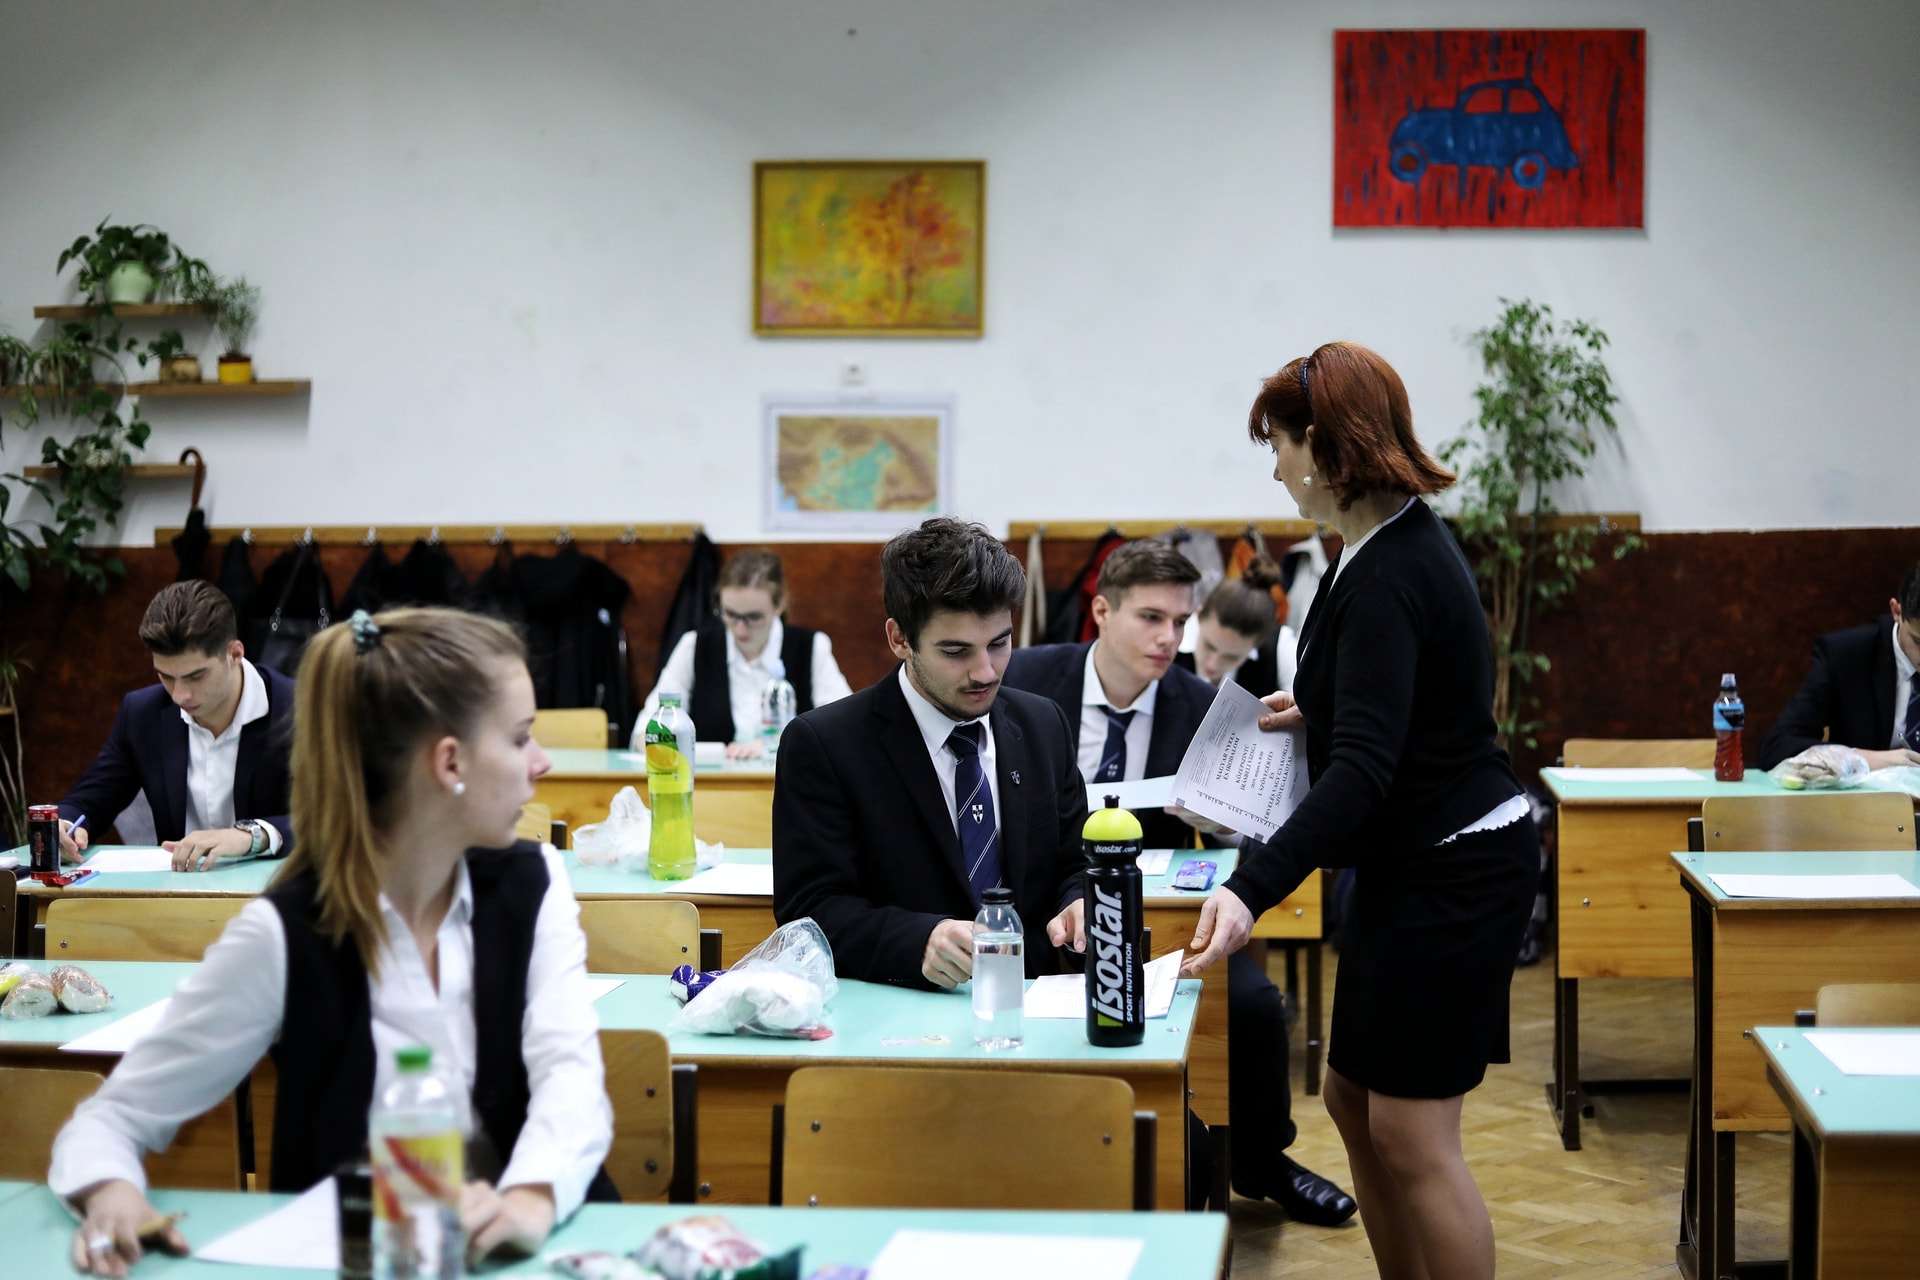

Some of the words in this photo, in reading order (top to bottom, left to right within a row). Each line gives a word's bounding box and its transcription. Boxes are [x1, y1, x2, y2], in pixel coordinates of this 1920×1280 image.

[1216, 752, 1228, 780] MAGYAR
[1225, 731, 1236, 752] NYELV
[1225, 737, 1240, 772] IRODALOM
[1090, 883, 1124, 1021] isostar
[1125, 942, 1133, 992] NUTRITION
[1126, 994, 1134, 1023] SPORT
